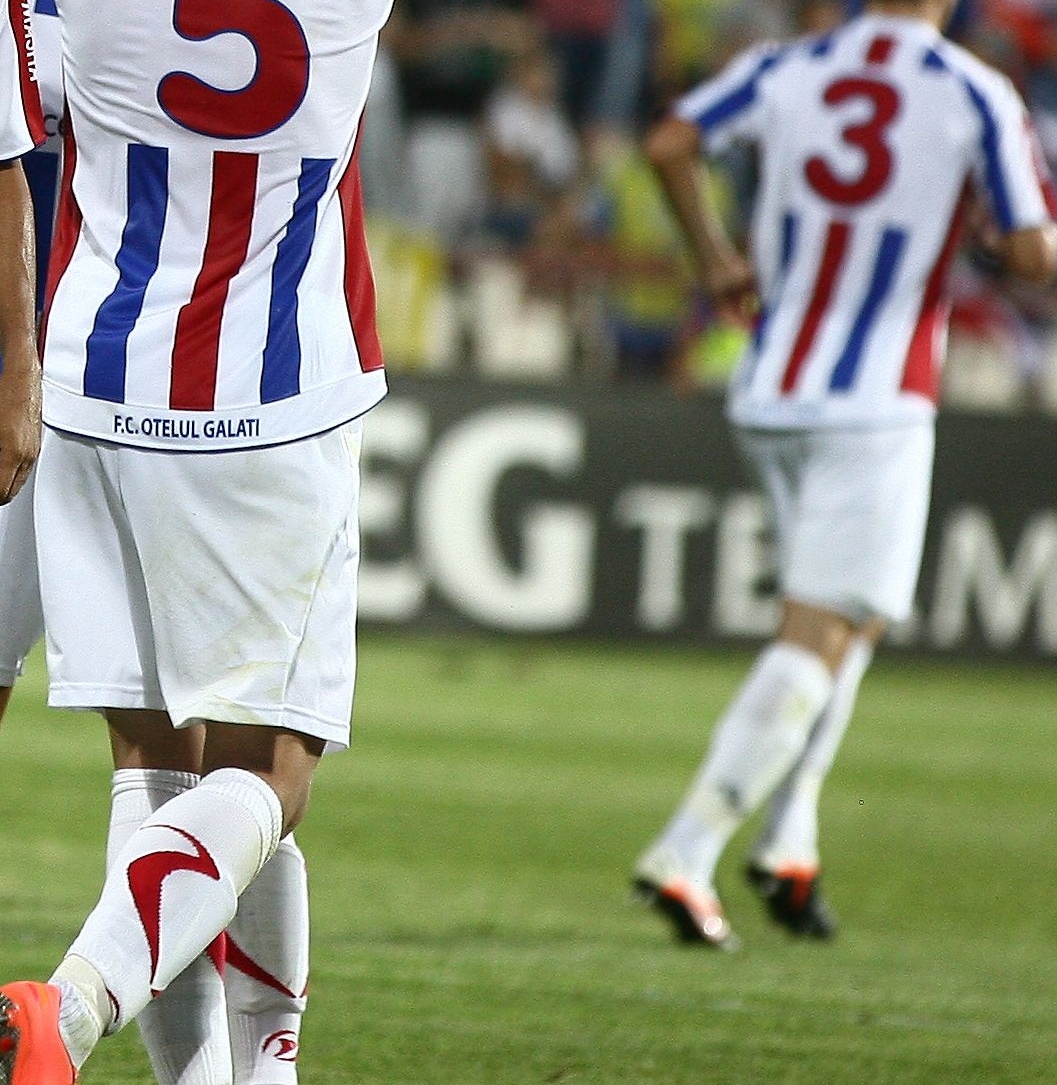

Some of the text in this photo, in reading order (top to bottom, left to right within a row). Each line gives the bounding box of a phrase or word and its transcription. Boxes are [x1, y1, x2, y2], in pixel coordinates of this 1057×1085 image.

[804, 77, 900, 207] 3
[114, 415, 260, 438] F.C. OTELUL GALATI
